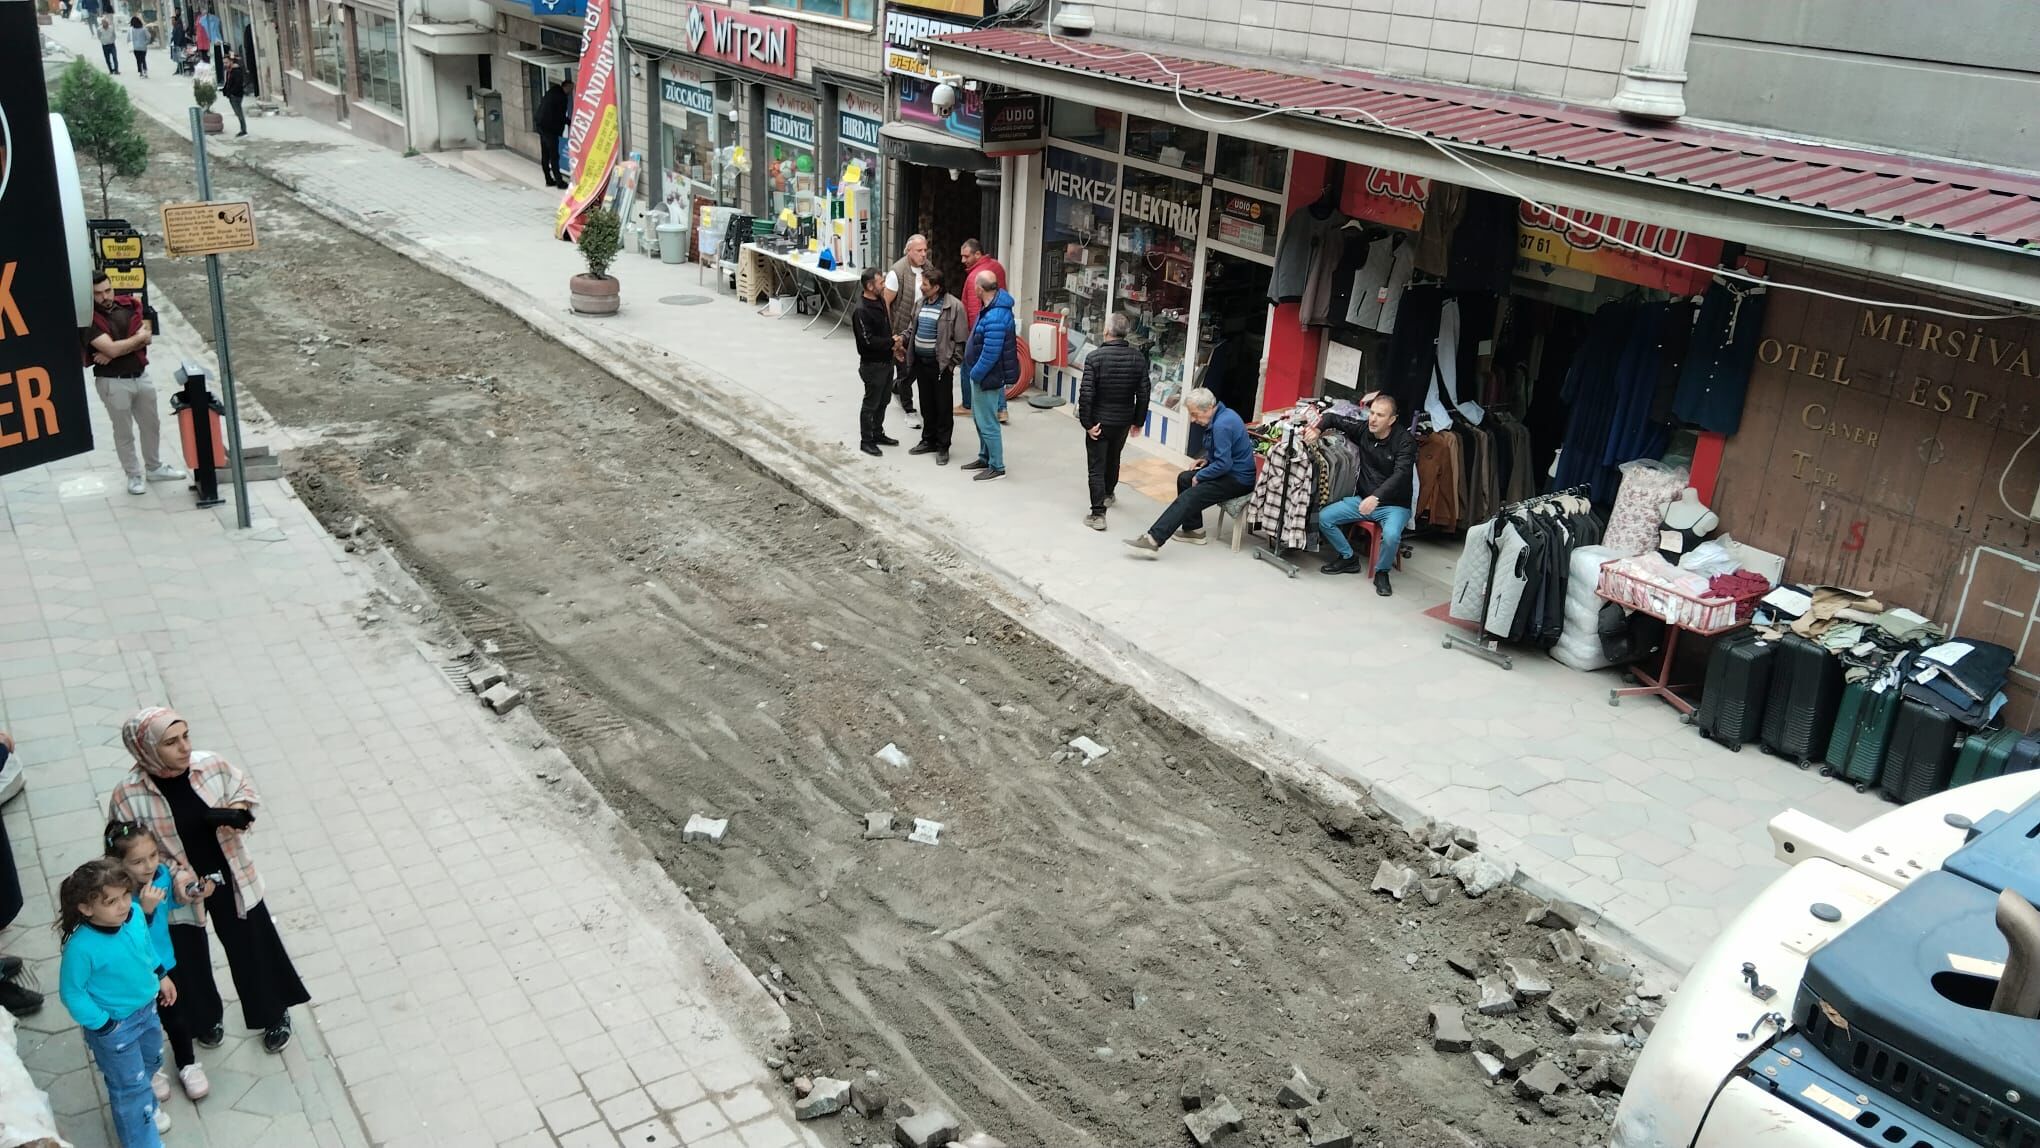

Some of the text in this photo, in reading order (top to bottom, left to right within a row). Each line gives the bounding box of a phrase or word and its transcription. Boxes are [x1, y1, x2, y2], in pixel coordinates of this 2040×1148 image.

[1045, 167, 1116, 209] MERKEZ
[1121, 188, 1200, 236] ELEKTRİK
[107, 244, 136, 252] TUBORG
[1520, 234, 1550, 254] 37 61
[1757, 338, 1852, 386] OTEL
[1860, 309, 2040, 380] MERSİVA
